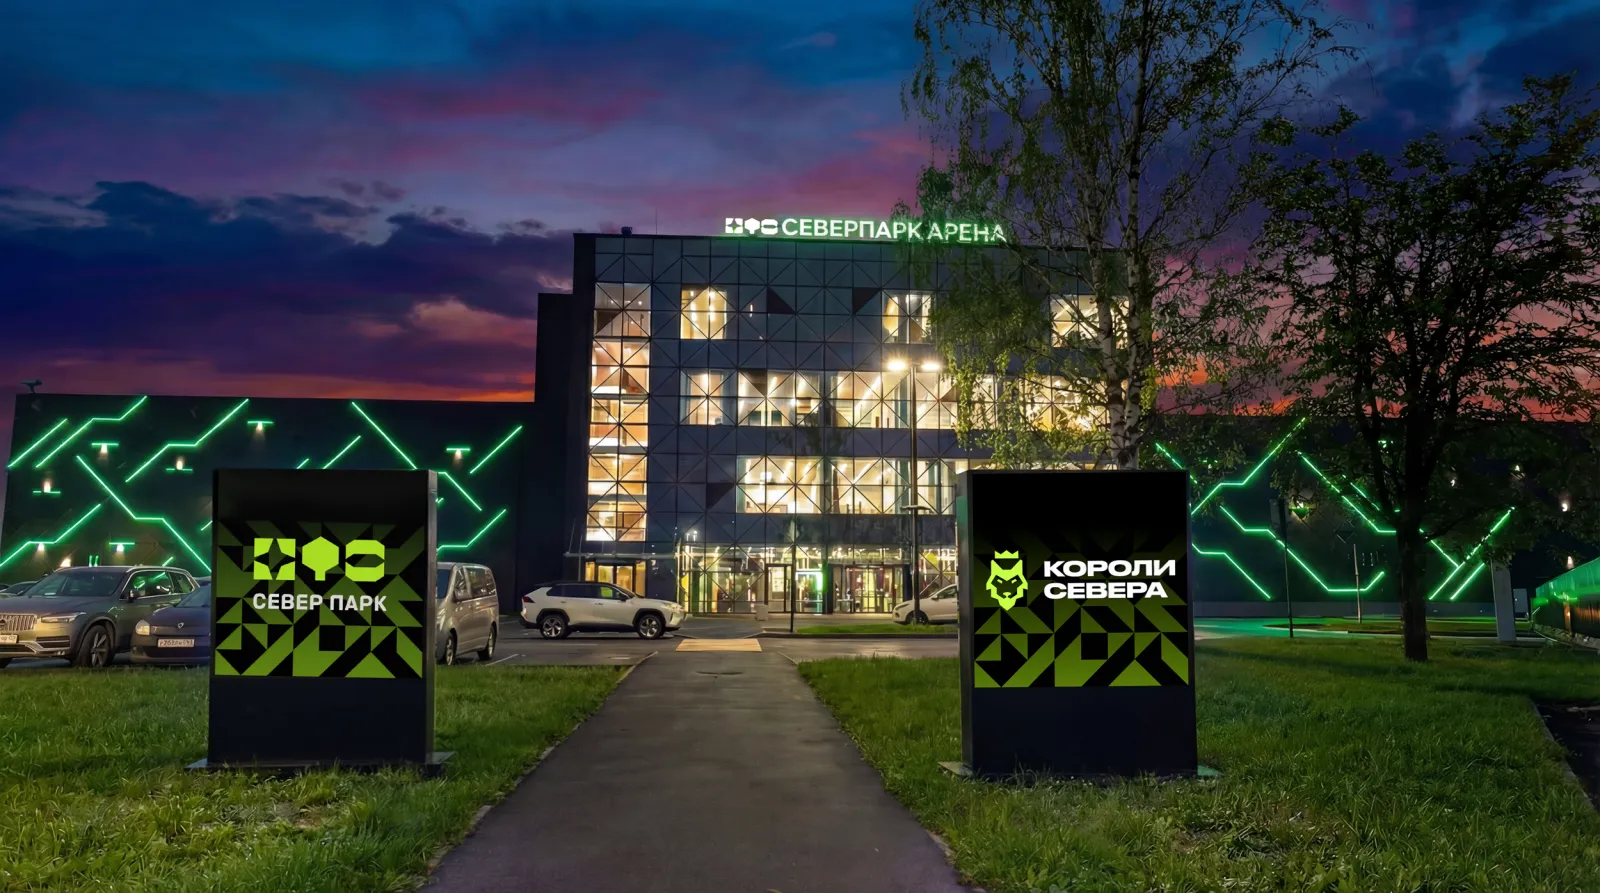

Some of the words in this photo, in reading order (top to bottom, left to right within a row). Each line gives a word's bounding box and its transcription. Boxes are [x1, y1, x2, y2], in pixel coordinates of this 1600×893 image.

[781, 218, 923, 241] СЕВЕРПАРК
[927, 221, 1007, 242] АРЕНА
[1043, 559, 1176, 577] КОРОЛИ
[1043, 582, 1169, 600] СЕВЕРА
[252, 593, 323, 611] СЕВЕР
[329, 594, 387, 612] ПАРК
